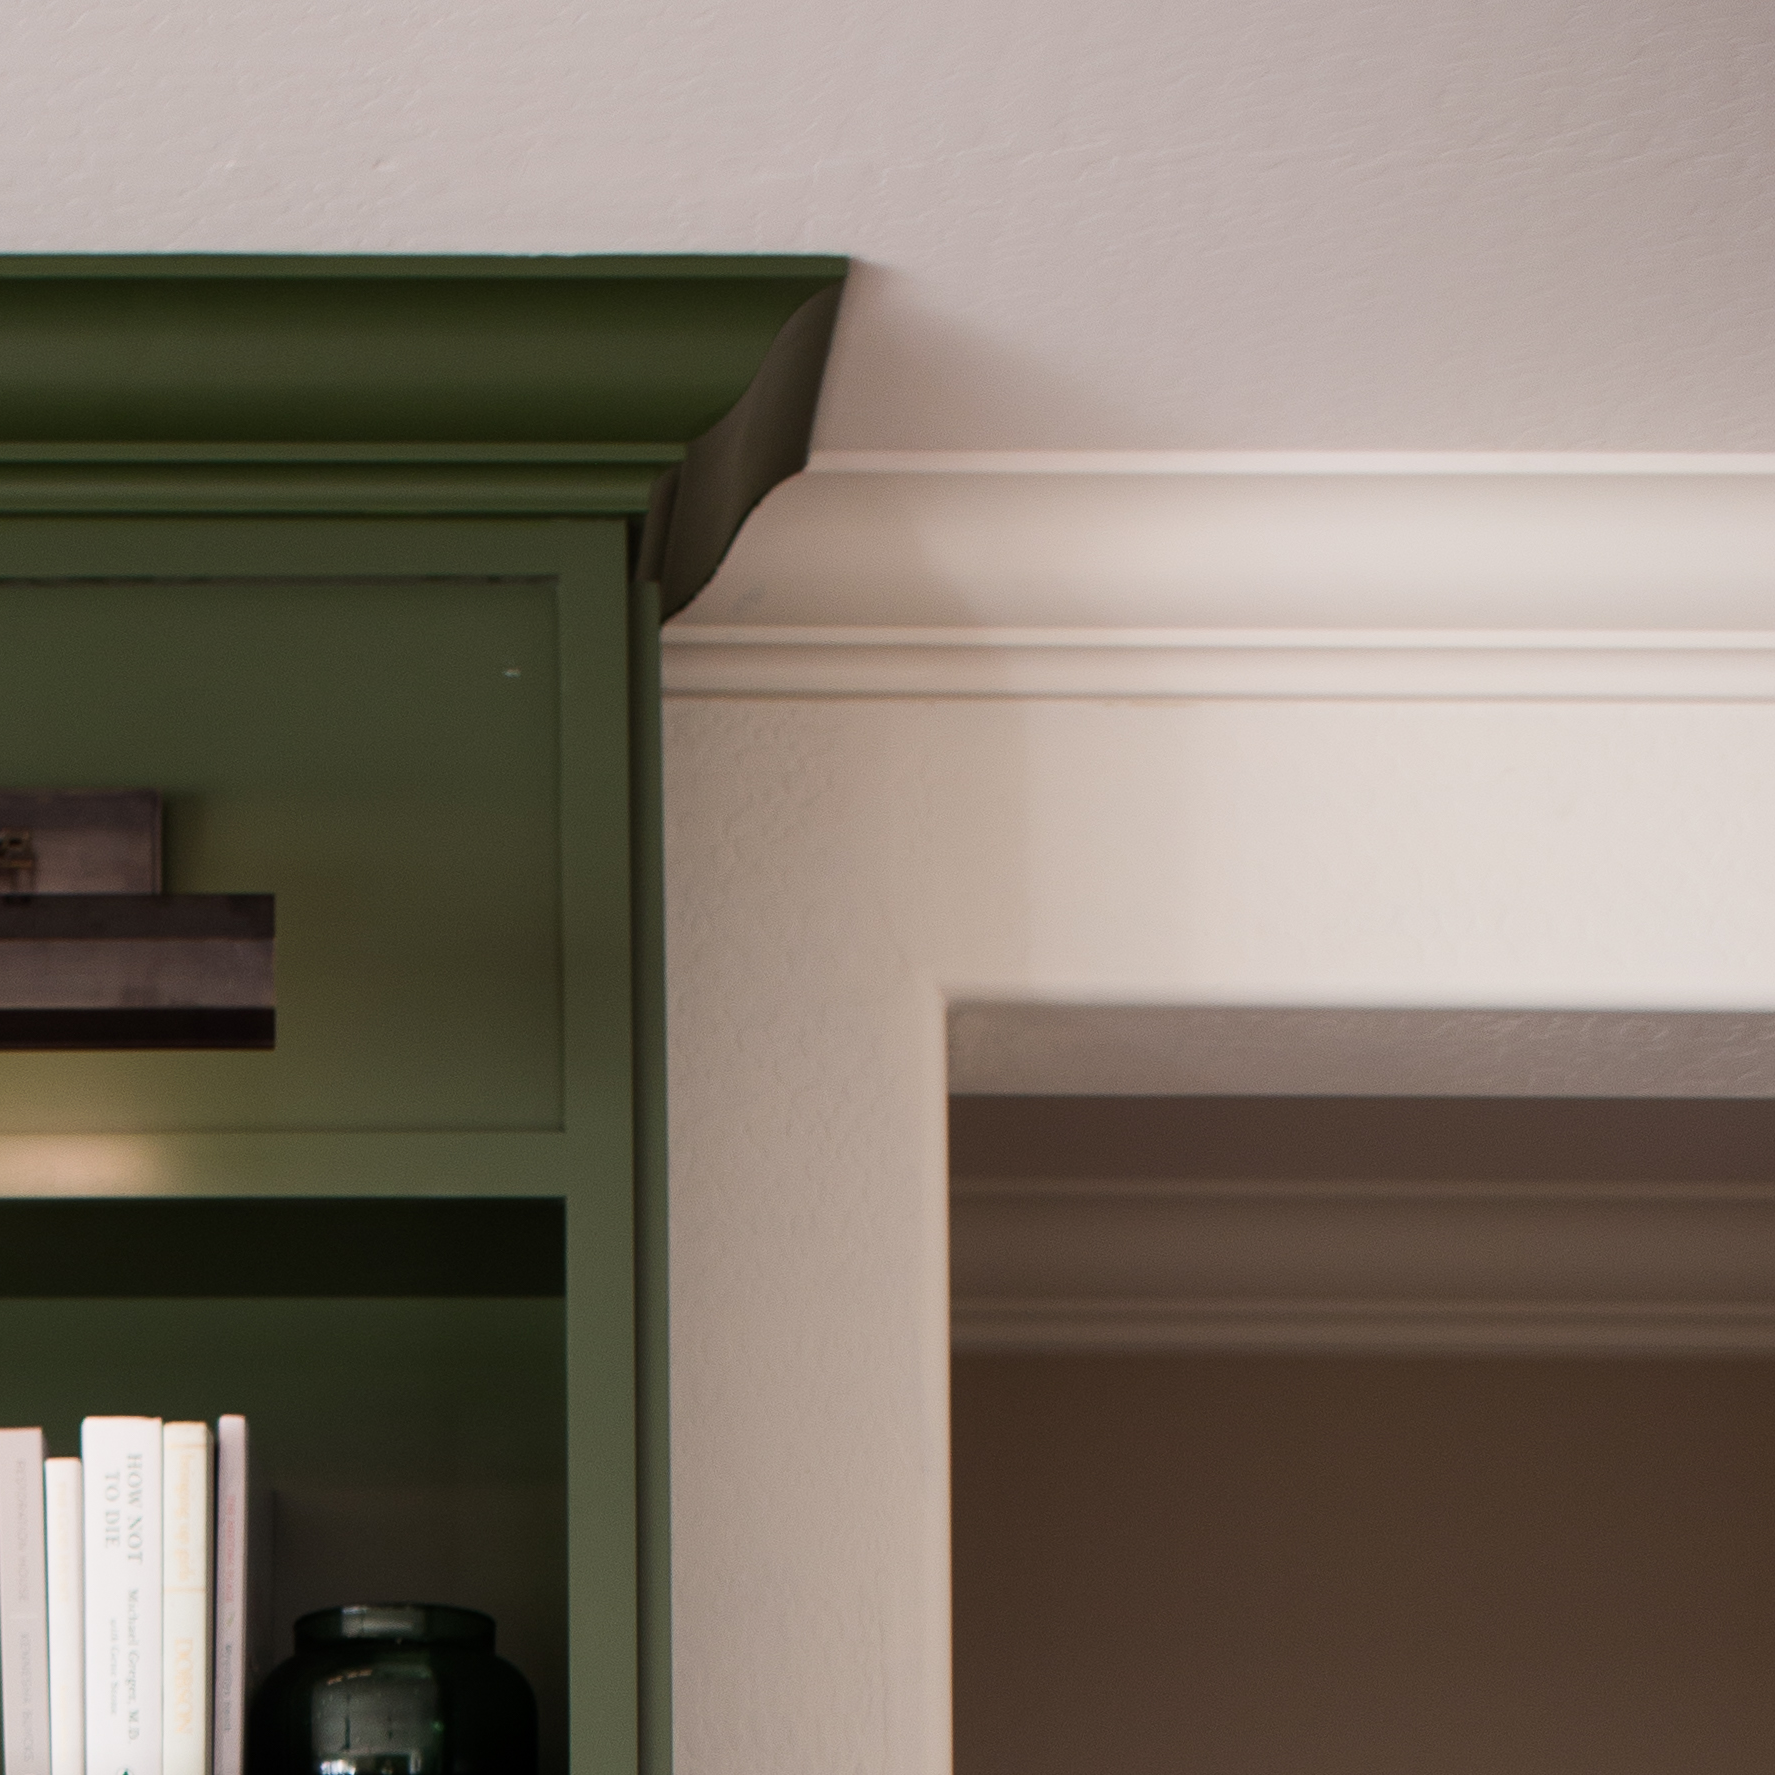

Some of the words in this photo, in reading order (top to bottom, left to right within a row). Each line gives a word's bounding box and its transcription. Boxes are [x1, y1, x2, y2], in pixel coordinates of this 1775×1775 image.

[104, 1471, 121, 1503] TO
[127, 1452, 144, 1509] HOW
[174, 1453, 196, 1520] bringing
[104, 1509, 121, 1549] DIE
[127, 1514, 144, 1566] NOT
[174, 1523, 192, 1545] up
[174, 1548, 196, 1582] girls
[126, 1588, 140, 1647] Michael
[174, 1637, 194, 1736] DOBSON
[126, 1708, 140, 1745] M.D.
